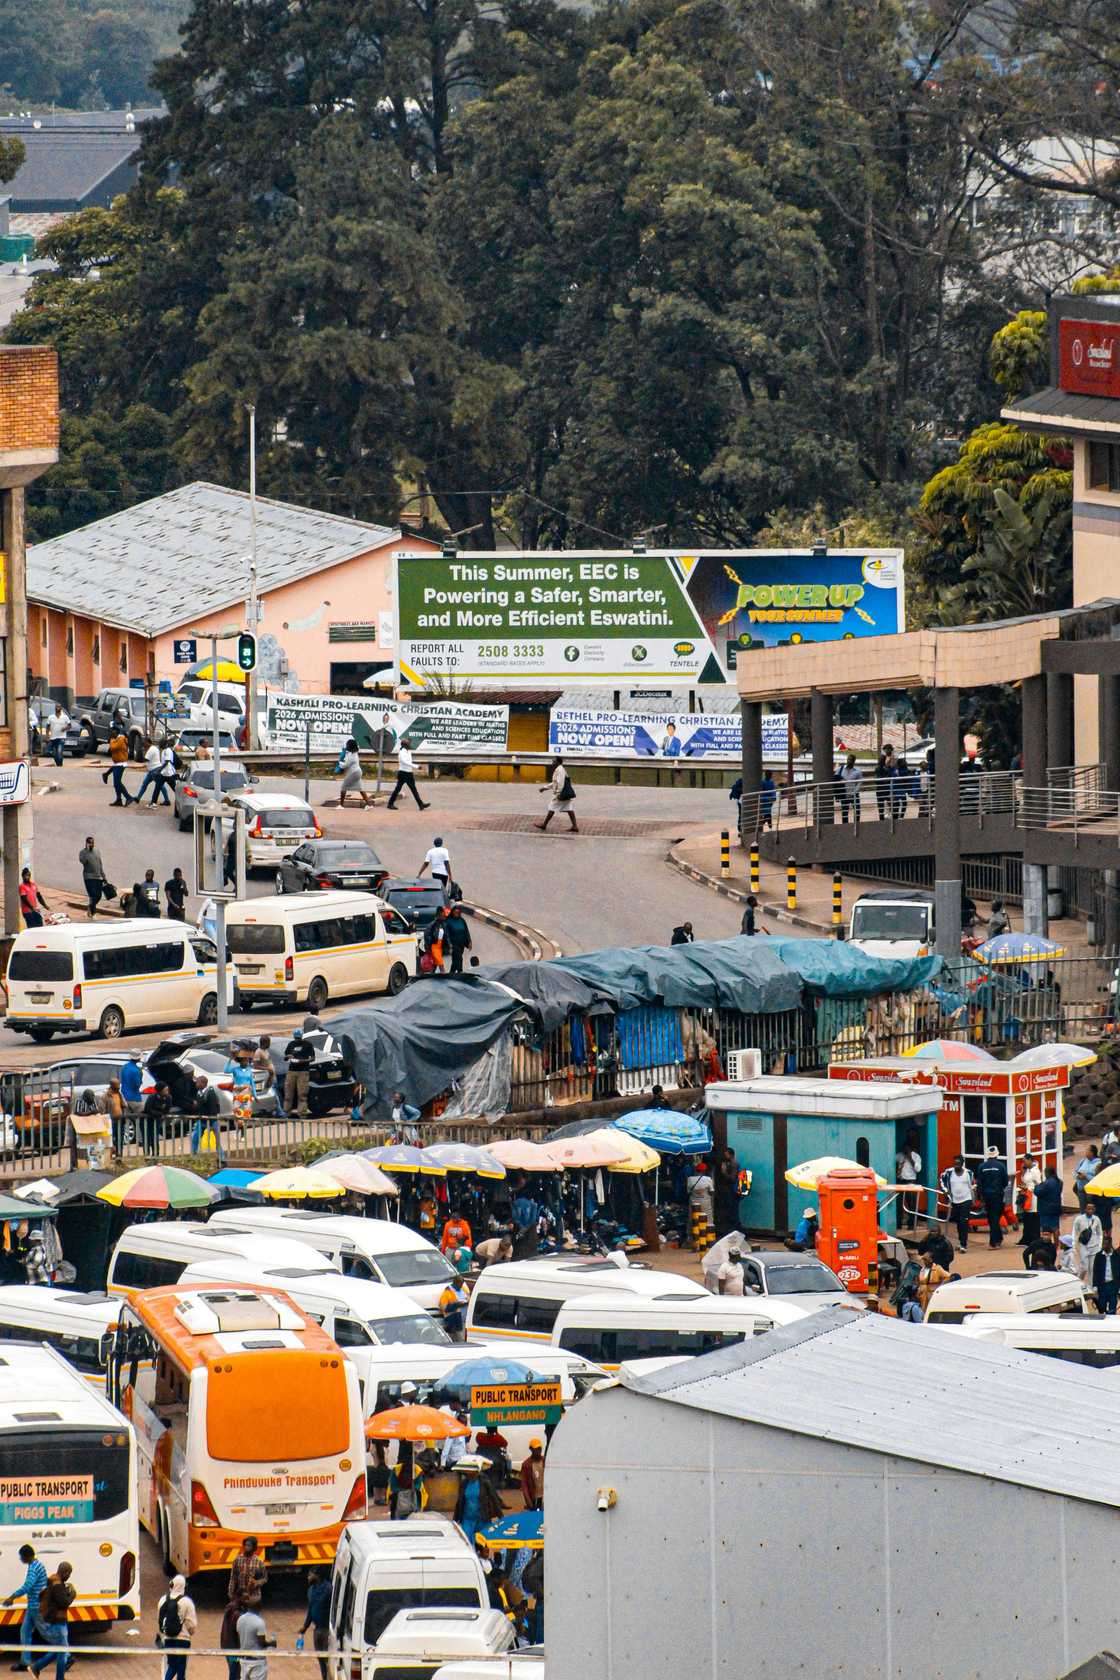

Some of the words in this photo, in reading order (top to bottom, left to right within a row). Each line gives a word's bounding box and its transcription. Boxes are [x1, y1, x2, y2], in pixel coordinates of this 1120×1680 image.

[449, 564, 488, 581] This
[493, 564, 574, 583] Summer,
[579, 563, 618, 580] EEC
[623, 564, 640, 580] is
[423, 587, 509, 607] Powering
[514, 590, 525, 603] a
[530, 587, 583, 606] Safer,
[588, 586, 666, 606] Smarter,
[737, 583, 829, 608] POWER
[829, 583, 865, 608] UP
[417, 610, 451, 627] and
[456, 610, 503, 627] More
[508, 610, 585, 626] Efficient
[590, 609, 673, 626] Eswatini.
[748, 609, 785, 623] YOUR
[785, 609, 845, 623] SUMMER
[410, 643, 445, 653] REPORT
[448, 644, 464, 653] ALL
[478, 645, 508, 657] 2508
[513, 645, 544, 657] 3333
[410, 656, 443, 666] FAULTS
[446, 657, 460, 666] TO:
[275, 709, 296, 719] 2026
[298, 712, 354, 722] ADMISSIONS
[276, 698, 319, 708] KASHALI
[322, 700, 397, 713] PRO-LEARNING
[401, 705, 452, 715] CHRISTIAN
[455, 708, 504, 718] ACADEMY
[556, 711, 593, 721] BETHEL
[597, 713, 675, 724] PRO-LEARNING
[679, 715, 734, 726] CHRISTIAN
[276, 719, 308, 732] NOW
[313, 721, 353, 734] OPEN!
[580, 724, 636, 735] ADMISSIONS
[557, 732, 592, 745] NOW
[594, 734, 635, 746] OPEN!
[944, 1100, 959, 1111] TM
[476, 1390, 506, 1403] PUBLIC
[509, 1388, 558, 1402] TRANSPORT
[286, 1474, 336, 1487] Transport
[0, 1482, 33, 1498] PUBLIC
[35, 1481, 89, 1497] TRANSPORT
[15, 1506, 45, 1520] PIGGS
[48, 1505, 75, 1519] PEAK
